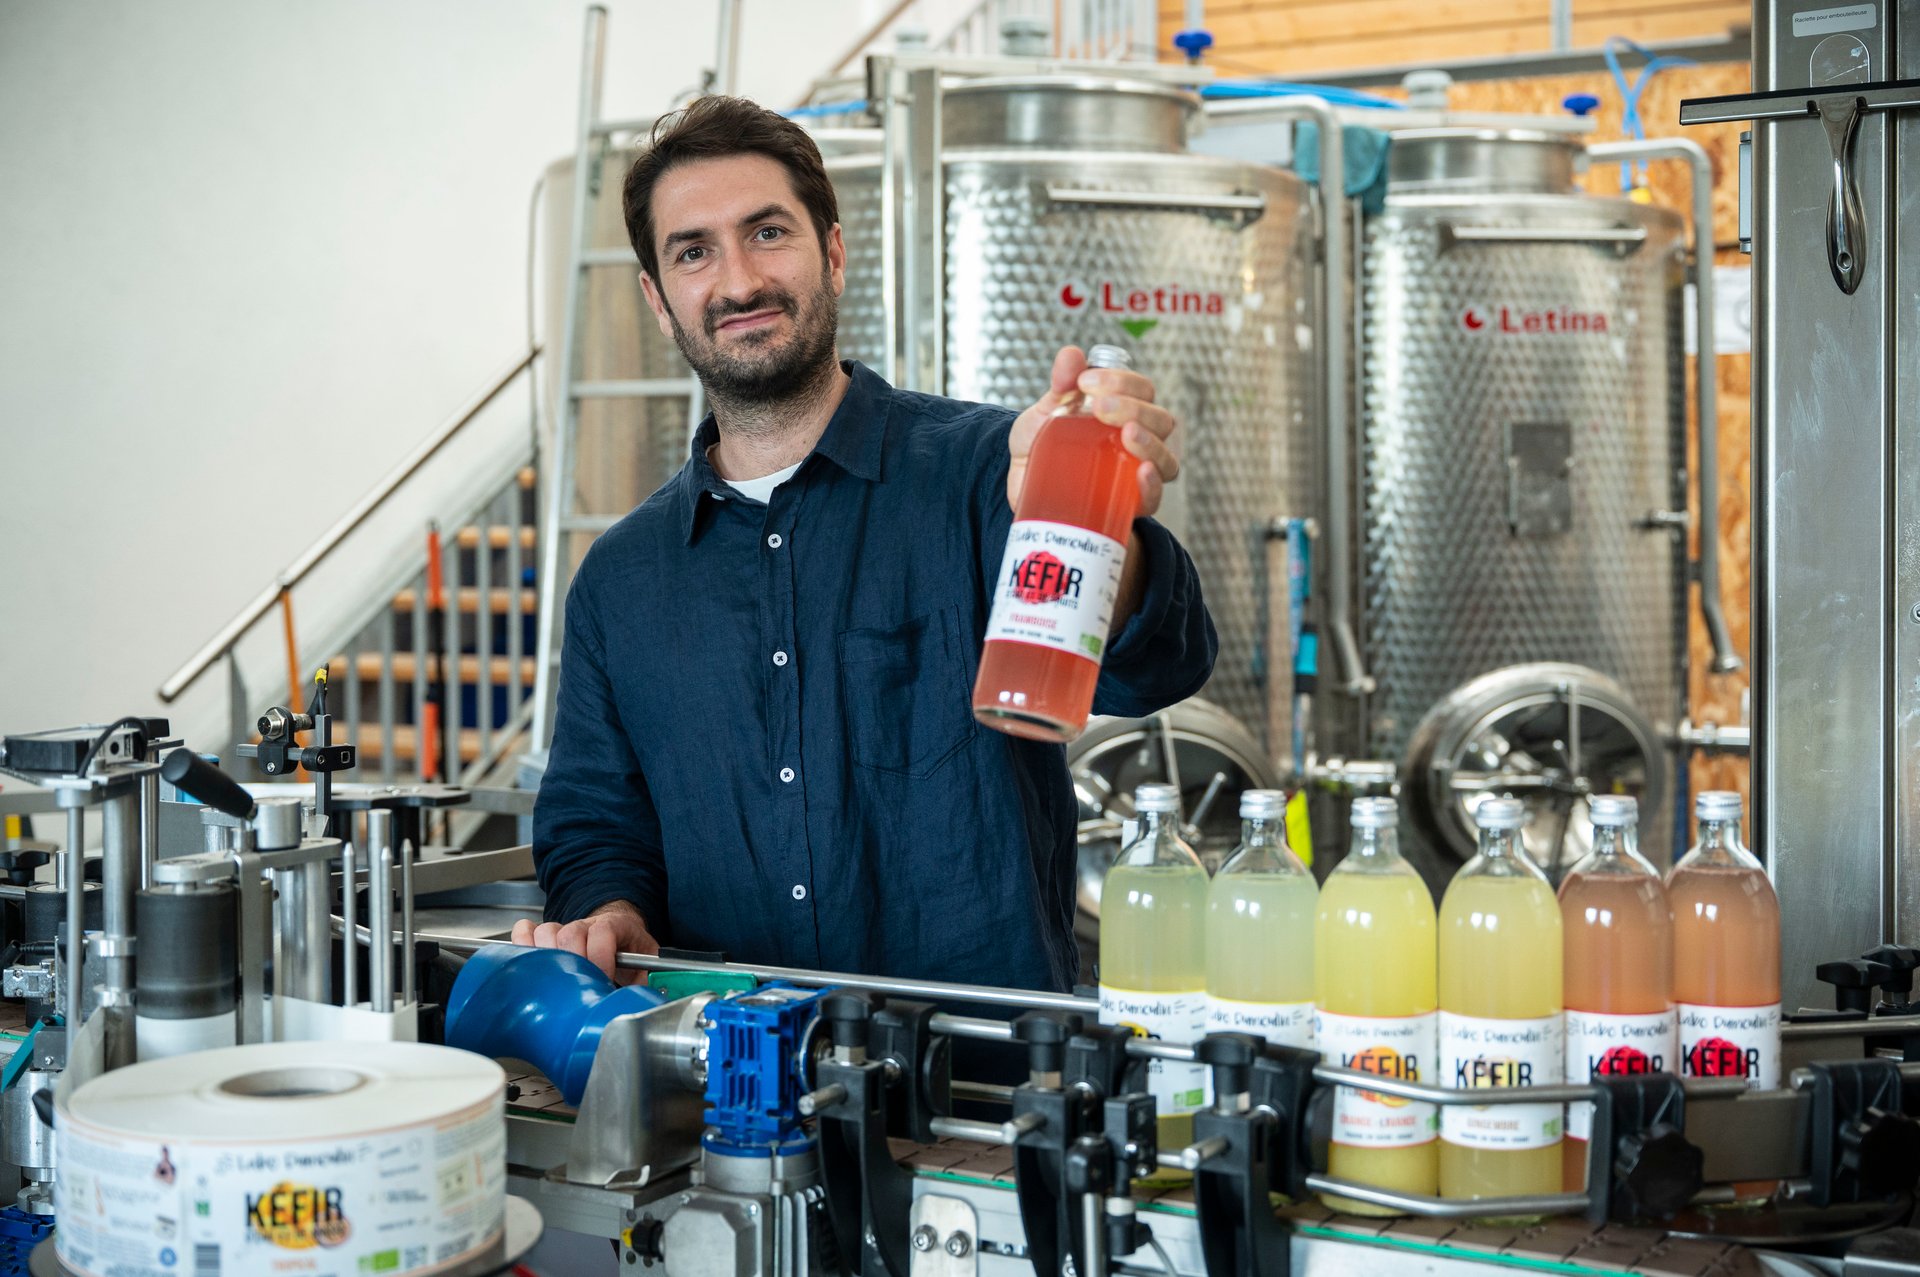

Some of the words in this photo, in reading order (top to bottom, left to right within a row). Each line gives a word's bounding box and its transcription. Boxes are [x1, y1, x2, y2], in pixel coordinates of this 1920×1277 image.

[1794, 15, 1816, 23] Raclette
[1828, 10, 1868, 19] embouteilleuse
[1103, 282, 1223, 315] Letina
[1500, 305, 1608, 334] Letina
[1008, 553, 1084, 598] KÉFIR
[1455, 1053, 1533, 1089] KÉFIR
[1682, 1039, 1760, 1079] KÉFIR
